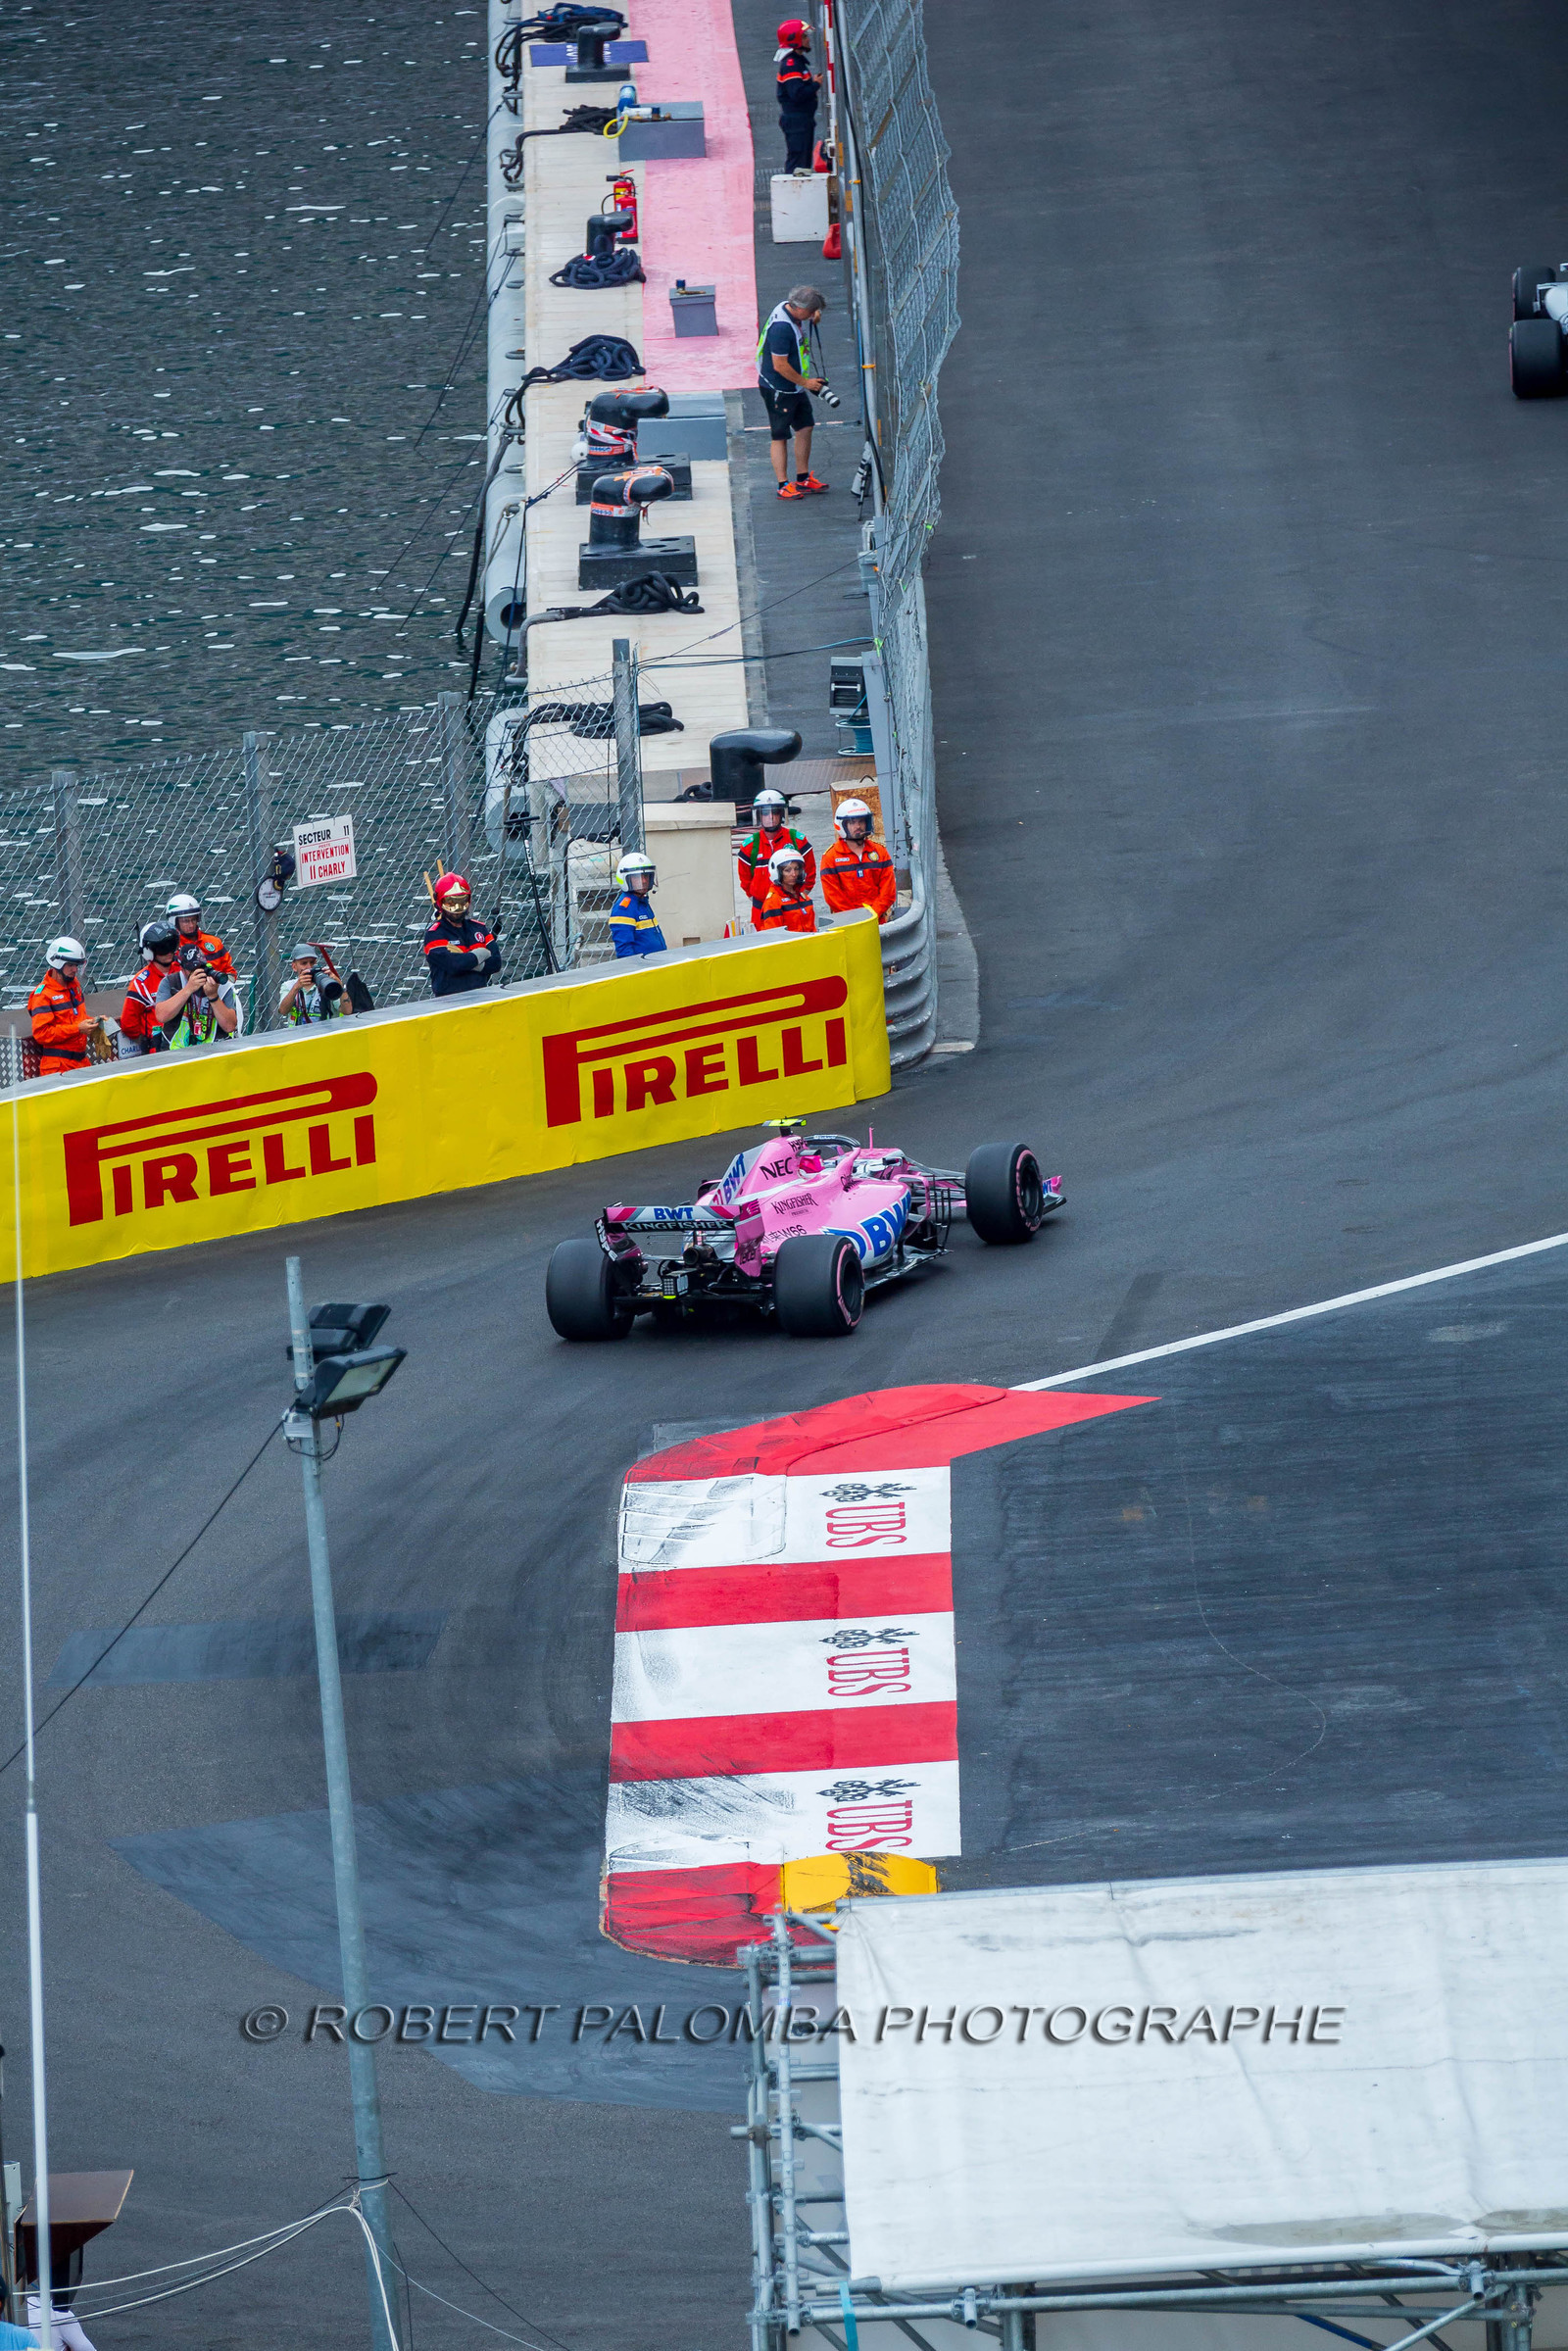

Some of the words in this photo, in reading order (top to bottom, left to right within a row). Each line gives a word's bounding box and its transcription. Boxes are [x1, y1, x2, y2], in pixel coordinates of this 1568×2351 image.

[298, 829, 331, 846] SECTEUR
[343, 825, 350, 836] 11
[301, 844, 349, 863] INTERVENTION
[318, 860, 346, 878] CHARLY
[122, 1046, 141, 1054] CHARL
[542, 975, 848, 1128] PIRELLI
[63, 1072, 377, 1227] PIRELLI
[723, 1152, 746, 1204] BWT
[760, 1157, 794, 1180] NEC
[1043, 1179, 1053, 1195] WT
[654, 1207, 694, 1220] BWT
[770, 1193, 818, 1215] KINGFISHER
[620, 1220, 733, 1232] KINGFISHER
[859, 1193, 911, 1258] BW
[596, 1219, 618, 1261] HYPE
[825, 1502, 907, 1547] UBS
[826, 1647, 911, 1696] UBS
[825, 1800, 912, 1851] UBS
